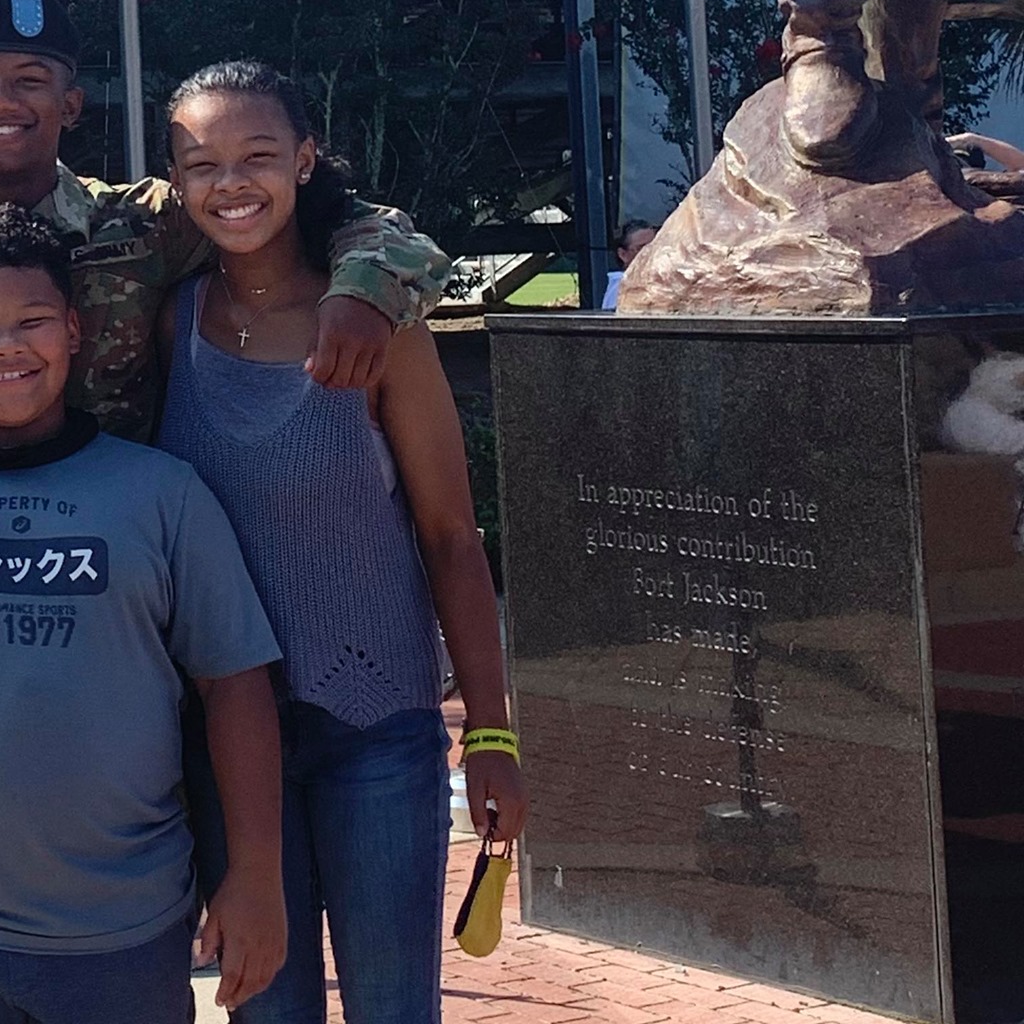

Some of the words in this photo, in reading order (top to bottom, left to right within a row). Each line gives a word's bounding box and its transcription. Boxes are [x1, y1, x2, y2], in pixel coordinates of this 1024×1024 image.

[57, 500, 78, 517] OF
[577, 474, 599, 503] In
[607, 484, 739, 516] appreciation
[748, 487, 771, 519] of
[781, 489, 819, 523] the
[585, 518, 669, 555] glorious
[677, 529, 817, 570] contribution
[680, 571, 768, 610] Jackson
[38, 604, 77, 616] SPORTS
[3, 614, 75, 648] 1977
